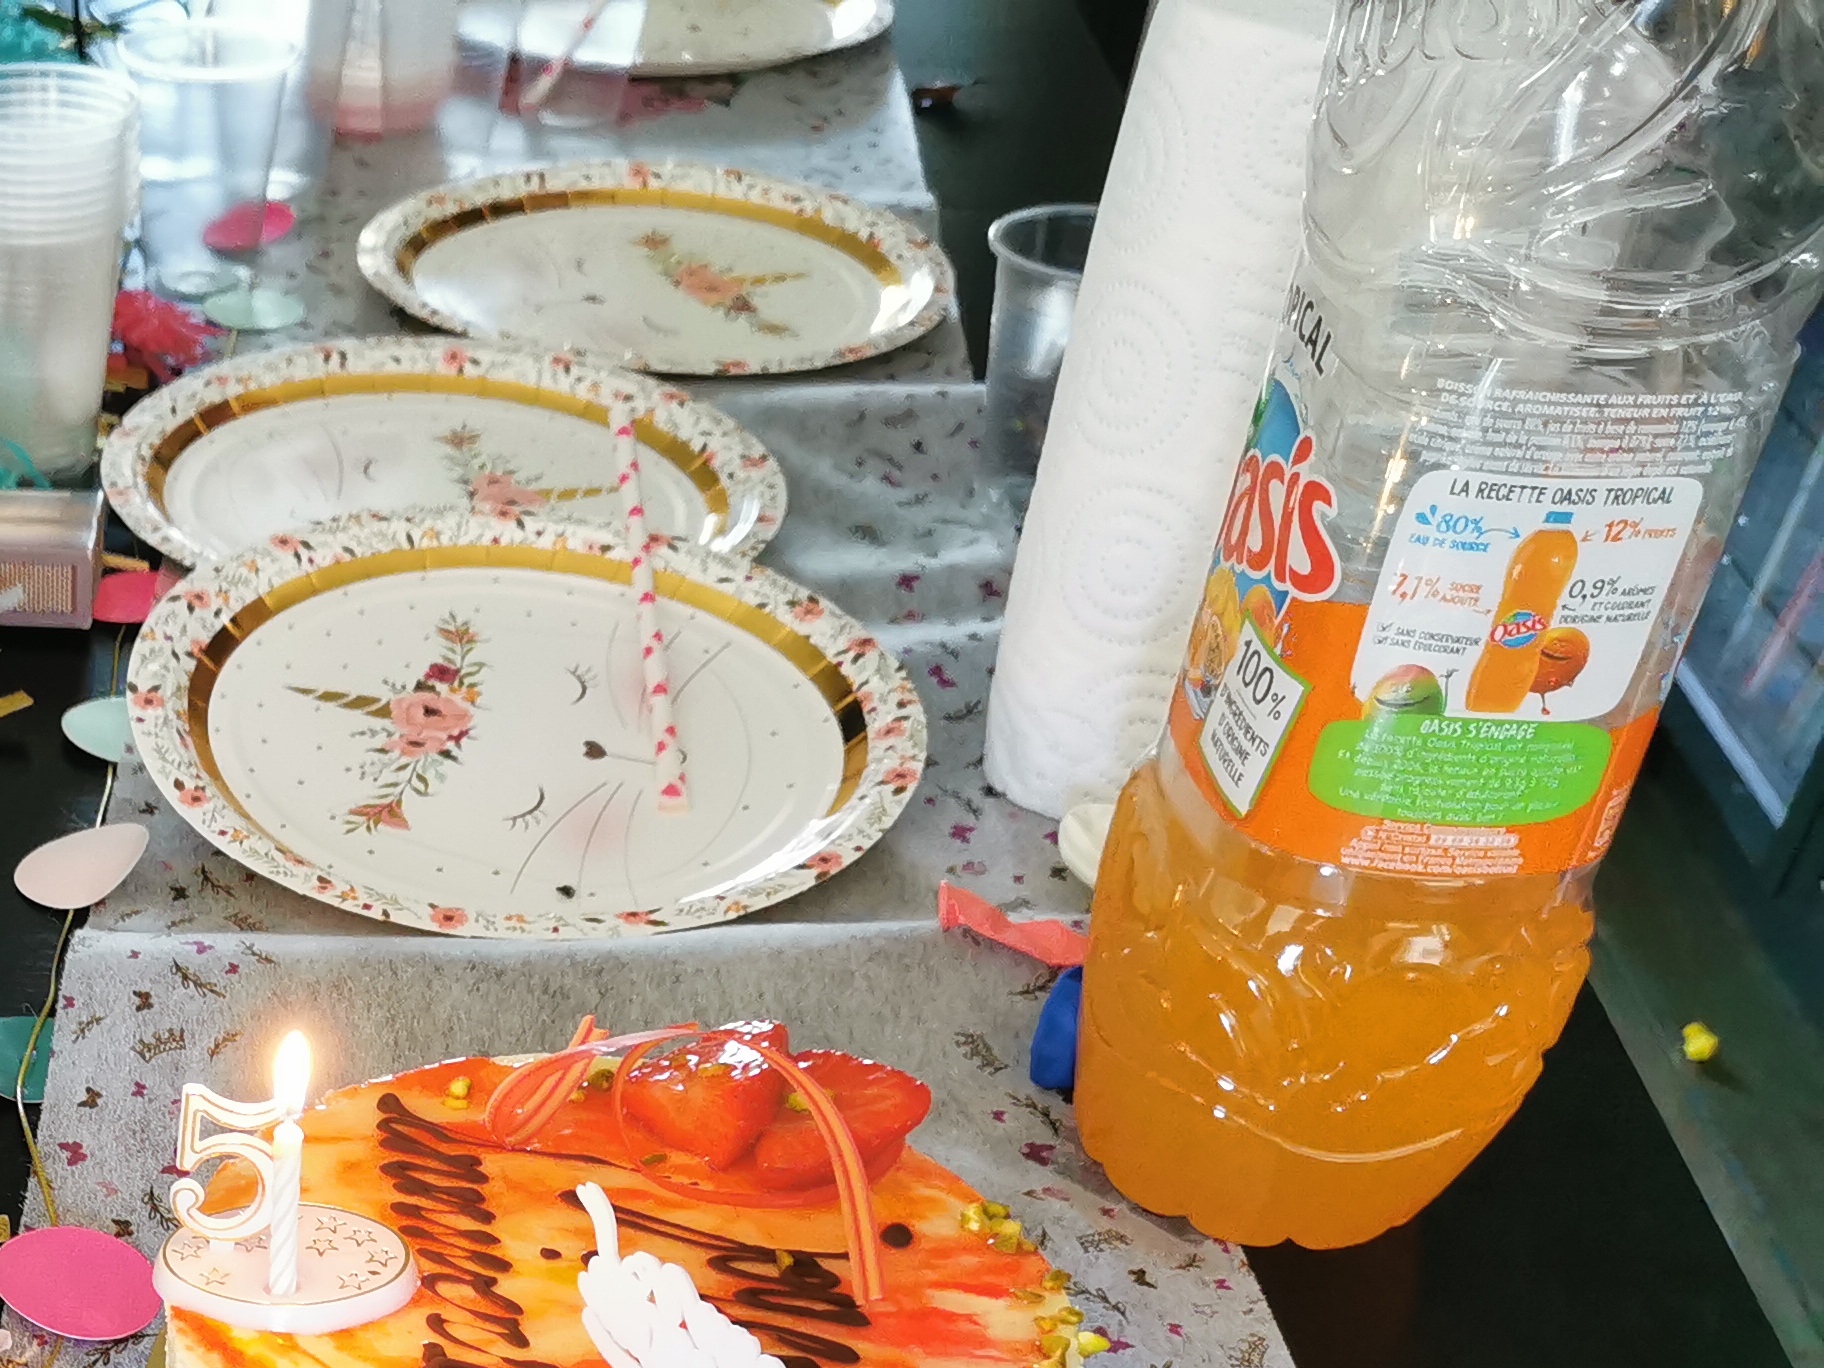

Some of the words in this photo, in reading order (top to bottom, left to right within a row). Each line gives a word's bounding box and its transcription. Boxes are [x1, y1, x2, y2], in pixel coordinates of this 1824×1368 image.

[1282, 284, 1332, 376] PICAL
[1449, 477, 1469, 498] LA
[1476, 481, 1548, 504] RECETTE
[1551, 487, 1597, 506] OASIS
[1603, 486, 1675, 507] TROPICAL
[1222, 435, 1335, 595] asis
[1436, 513, 1484, 540] 80%
[1603, 517, 1644, 543] 12%
[1568, 575, 1622, 607] 0,9%
[1236, 638, 1286, 721] 100%
[1420, 719, 1462, 737] OASIS
[169, 1082, 282, 1241] 5
